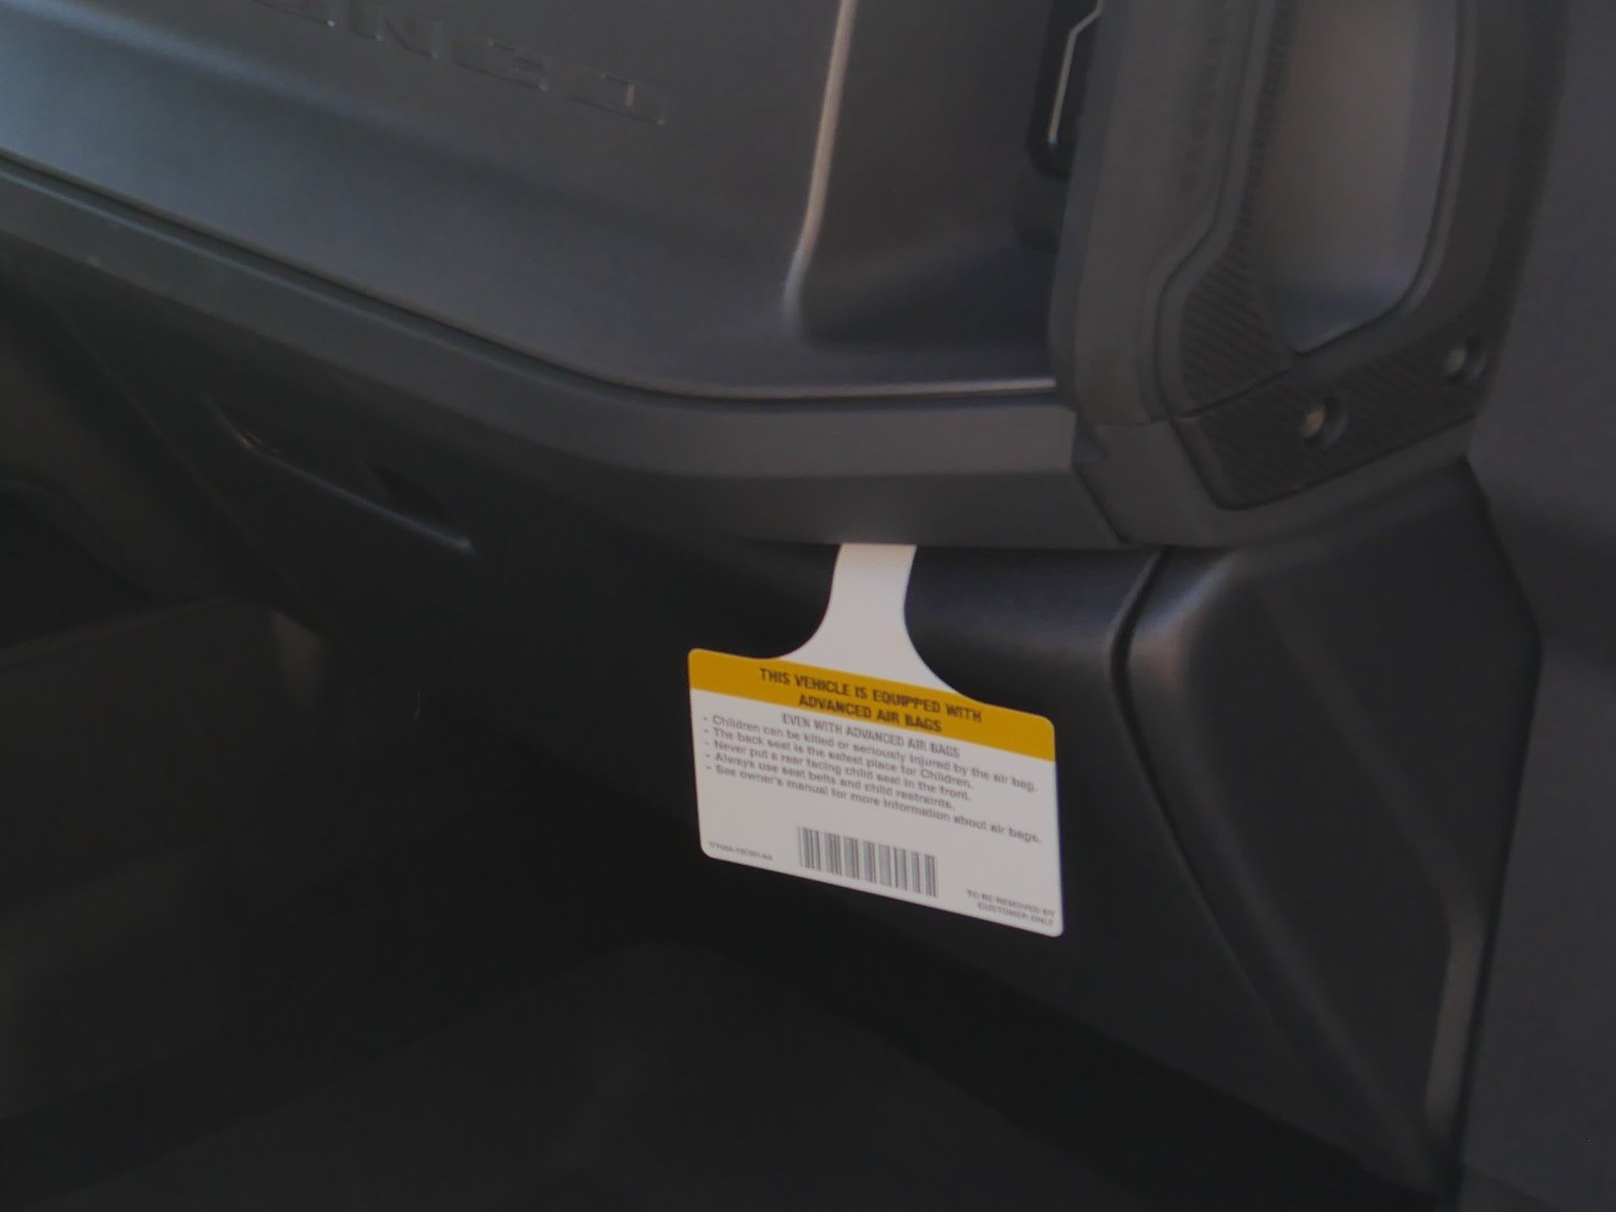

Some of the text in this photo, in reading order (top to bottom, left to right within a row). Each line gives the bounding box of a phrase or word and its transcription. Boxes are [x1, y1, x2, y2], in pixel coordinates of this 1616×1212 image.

[760, 668, 982, 722] THIS VEHICLE IS EQUIPPED WITH
[799, 694, 942, 732] ADVANCED AIR BAGS
[712, 715, 1038, 792] Children can be killed or seriously injured by the air bag.
[713, 727, 974, 788] The back seat is the safest place for Children.
[783, 713, 960, 759] EVEN WITH ADVANCED AIR BAGS
[714, 740, 746, 754] Never
[749, 748, 768, 759] put
[781, 754, 804, 766] rear
[806, 758, 842, 775] facing
[845, 766, 873, 780] child
[876, 773, 901, 786] seat
[904, 777, 916, 787] in
[918, 781, 938, 793] the
[940, 786, 971, 801] front.
[715, 752, 955, 810] Always use seat belts and child restraints.
[715, 765, 1042, 843] See owner's manual for more information about air bags.
